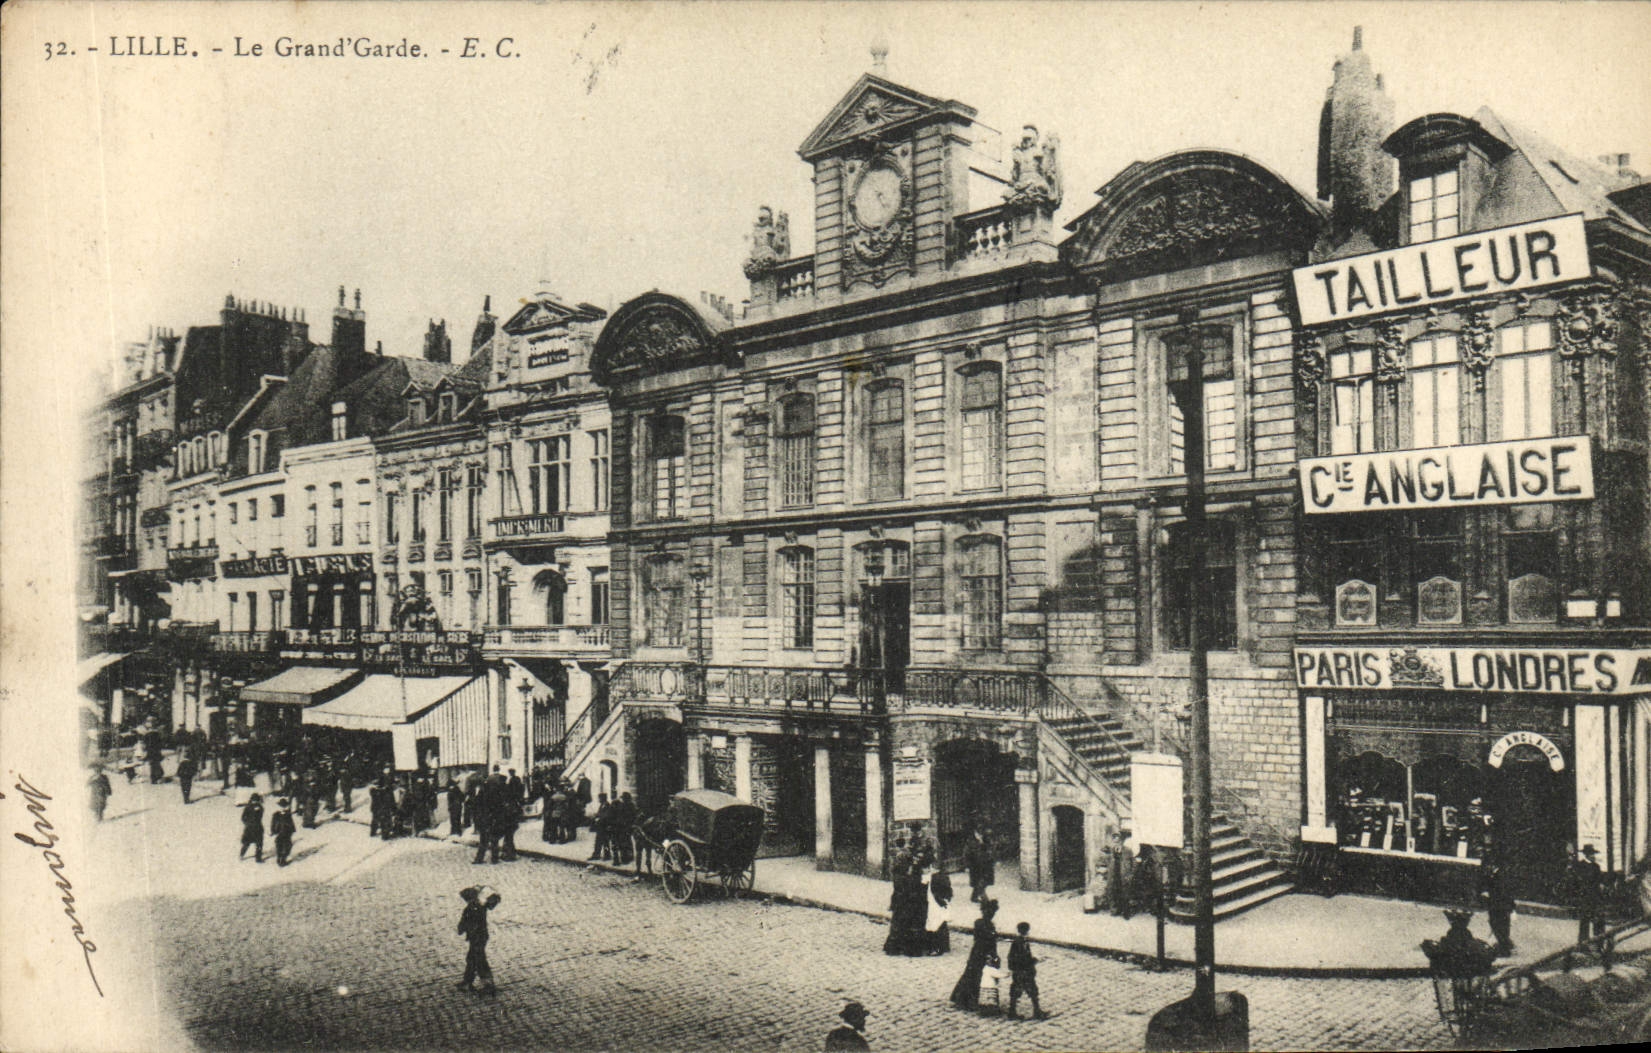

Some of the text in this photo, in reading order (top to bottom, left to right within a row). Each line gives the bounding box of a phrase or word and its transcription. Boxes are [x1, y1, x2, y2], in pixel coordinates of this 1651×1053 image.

[1314, 230, 1561, 317] TAILLEUR
[1364, 444, 1582, 506] ANGLAISE
[1297, 652, 1383, 686] PARIS
[1450, 653, 1619, 692] LONDRES
